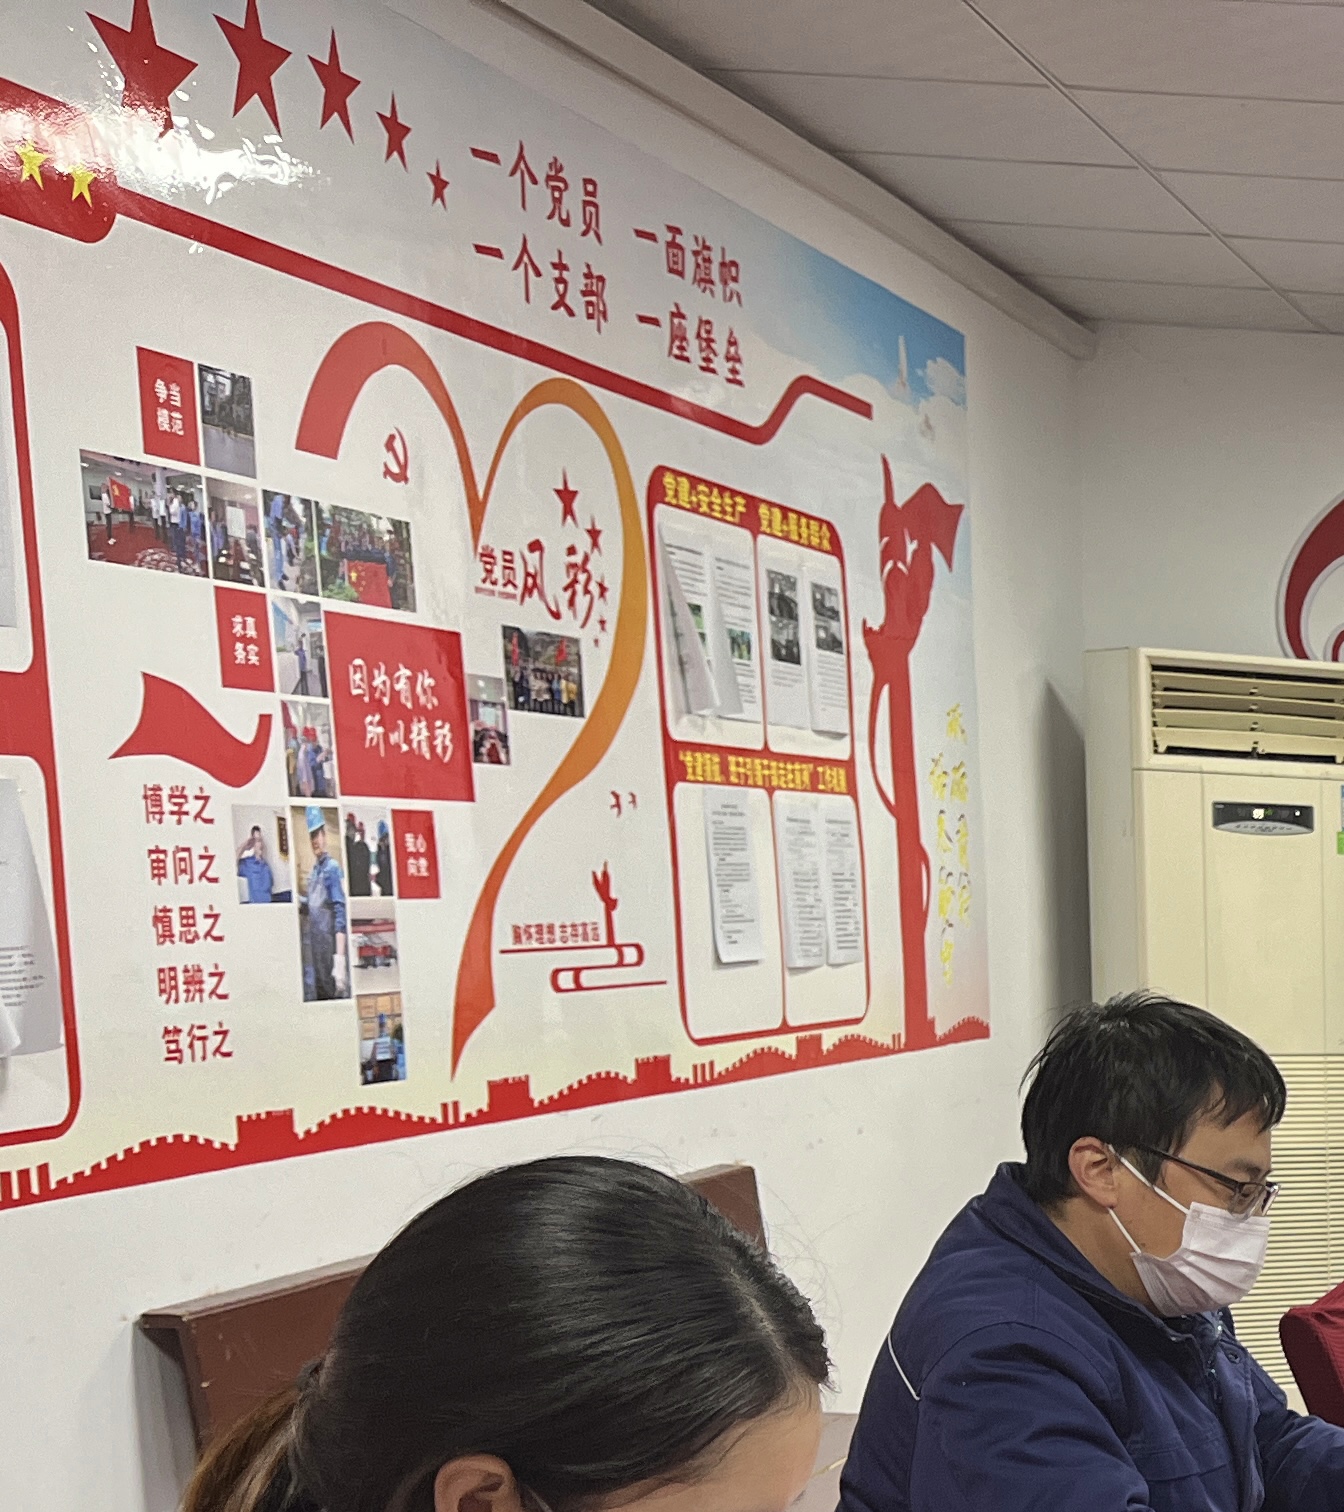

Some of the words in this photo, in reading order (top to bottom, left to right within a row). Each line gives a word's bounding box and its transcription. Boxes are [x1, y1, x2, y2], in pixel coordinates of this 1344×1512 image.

[469, 140, 603, 246] 一个党员
[633, 225, 744, 308] 一面旗帜
[473, 234, 609, 334] 一个支部
[637, 303, 745, 388] 一座堡垒
[230, 614, 258, 639] 求真
[233, 641, 260, 666] 务实
[348, 657, 440, 711] 因为有你
[364, 714, 455, 764] 所以精彩
[142, 784, 215, 826] 博学之
[147, 846, 220, 886] 审问之
[152, 905, 225, 946] 慎思之
[157, 964, 230, 1005] 明辨之
[161, 1022, 234, 1065] 笃行之
